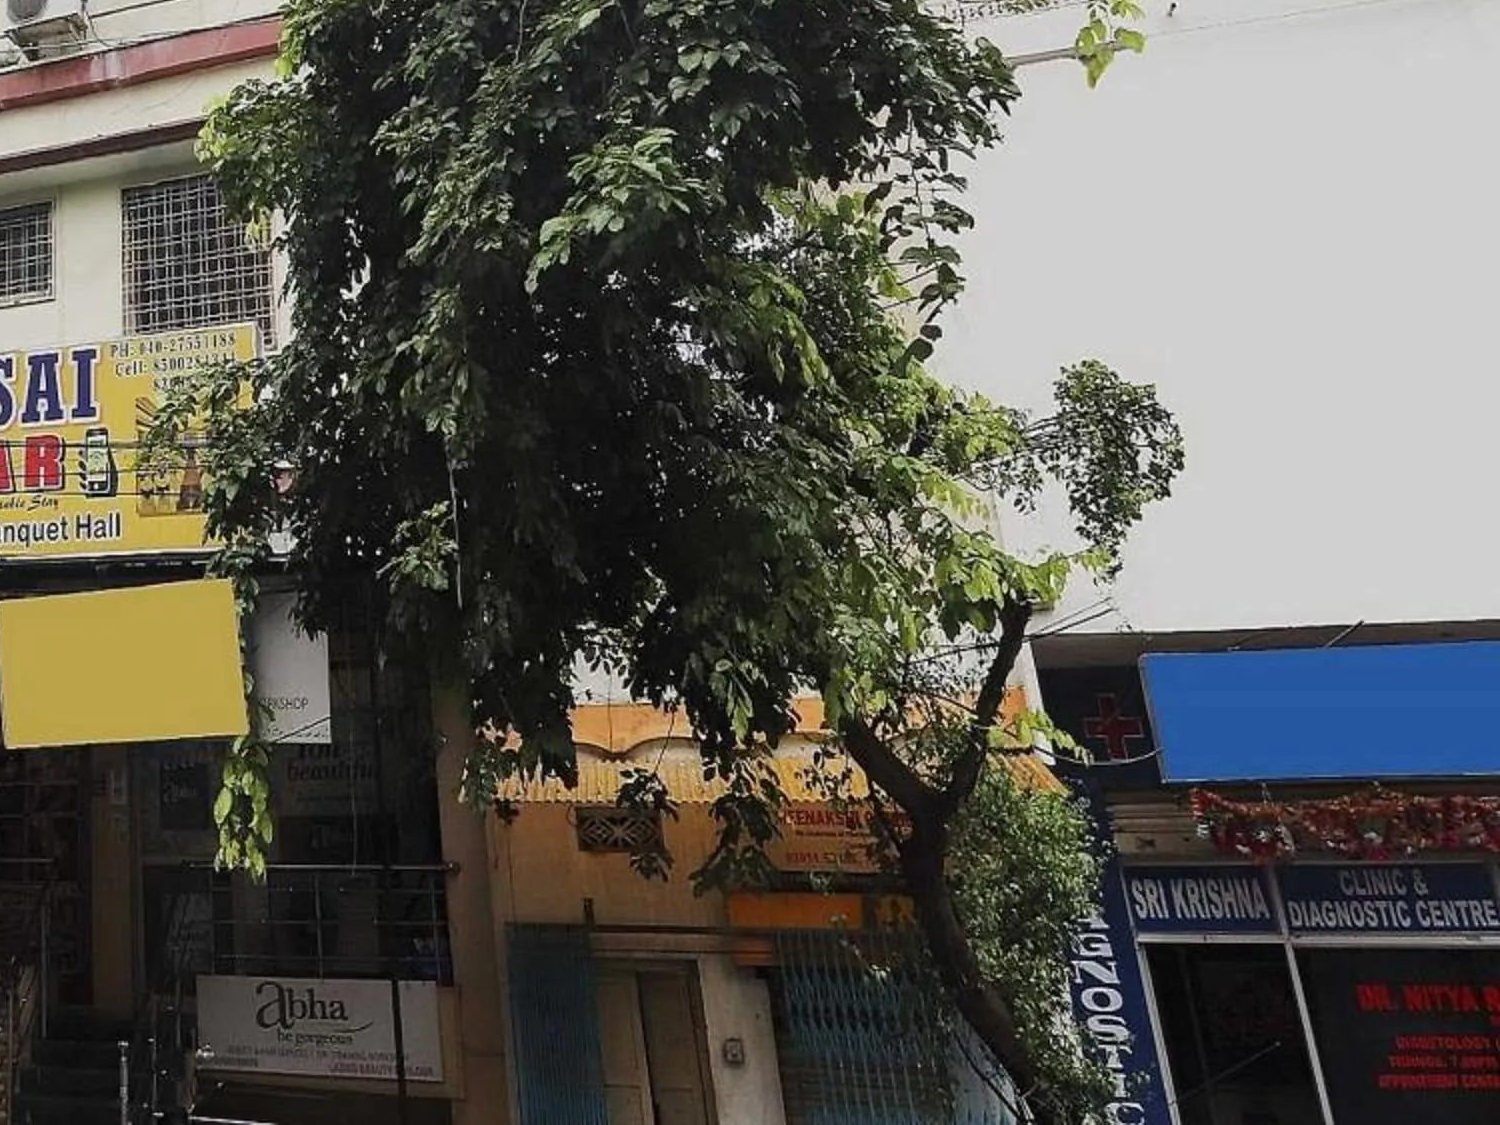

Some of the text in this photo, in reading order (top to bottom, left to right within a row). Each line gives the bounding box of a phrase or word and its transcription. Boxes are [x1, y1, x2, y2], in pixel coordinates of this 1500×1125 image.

[115, 360, 148, 377] Cell:
[76, 512, 122, 539] Hall
[1340, 871, 1429, 896] CLINIC &
[1130, 878, 1271, 920] SRI KRISHNA
[1288, 900, 1500, 929] DIAGNOSTIC CENTRE
